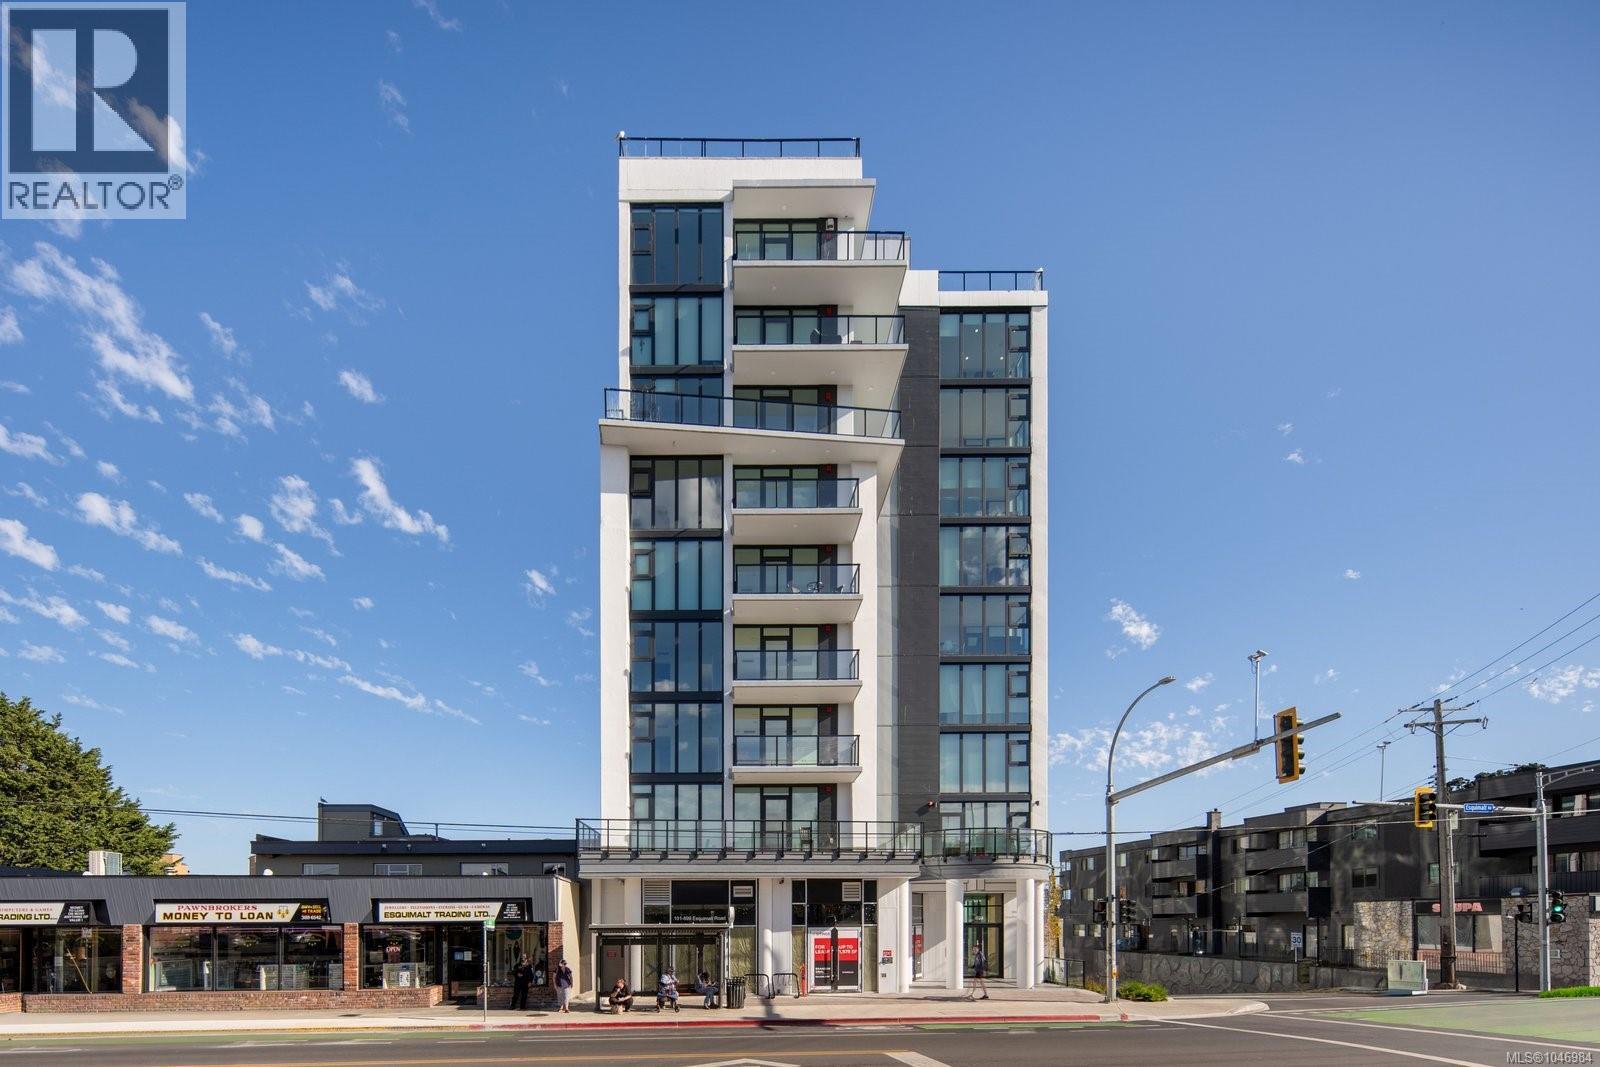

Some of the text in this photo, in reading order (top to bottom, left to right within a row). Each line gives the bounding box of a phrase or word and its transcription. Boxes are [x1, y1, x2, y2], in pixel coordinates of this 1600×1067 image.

[163, 912, 273, 920] MONEY TO LOAN
[384, 911, 431, 919] ESQUIMALT
[1292, 936, 1302, 944] 30
